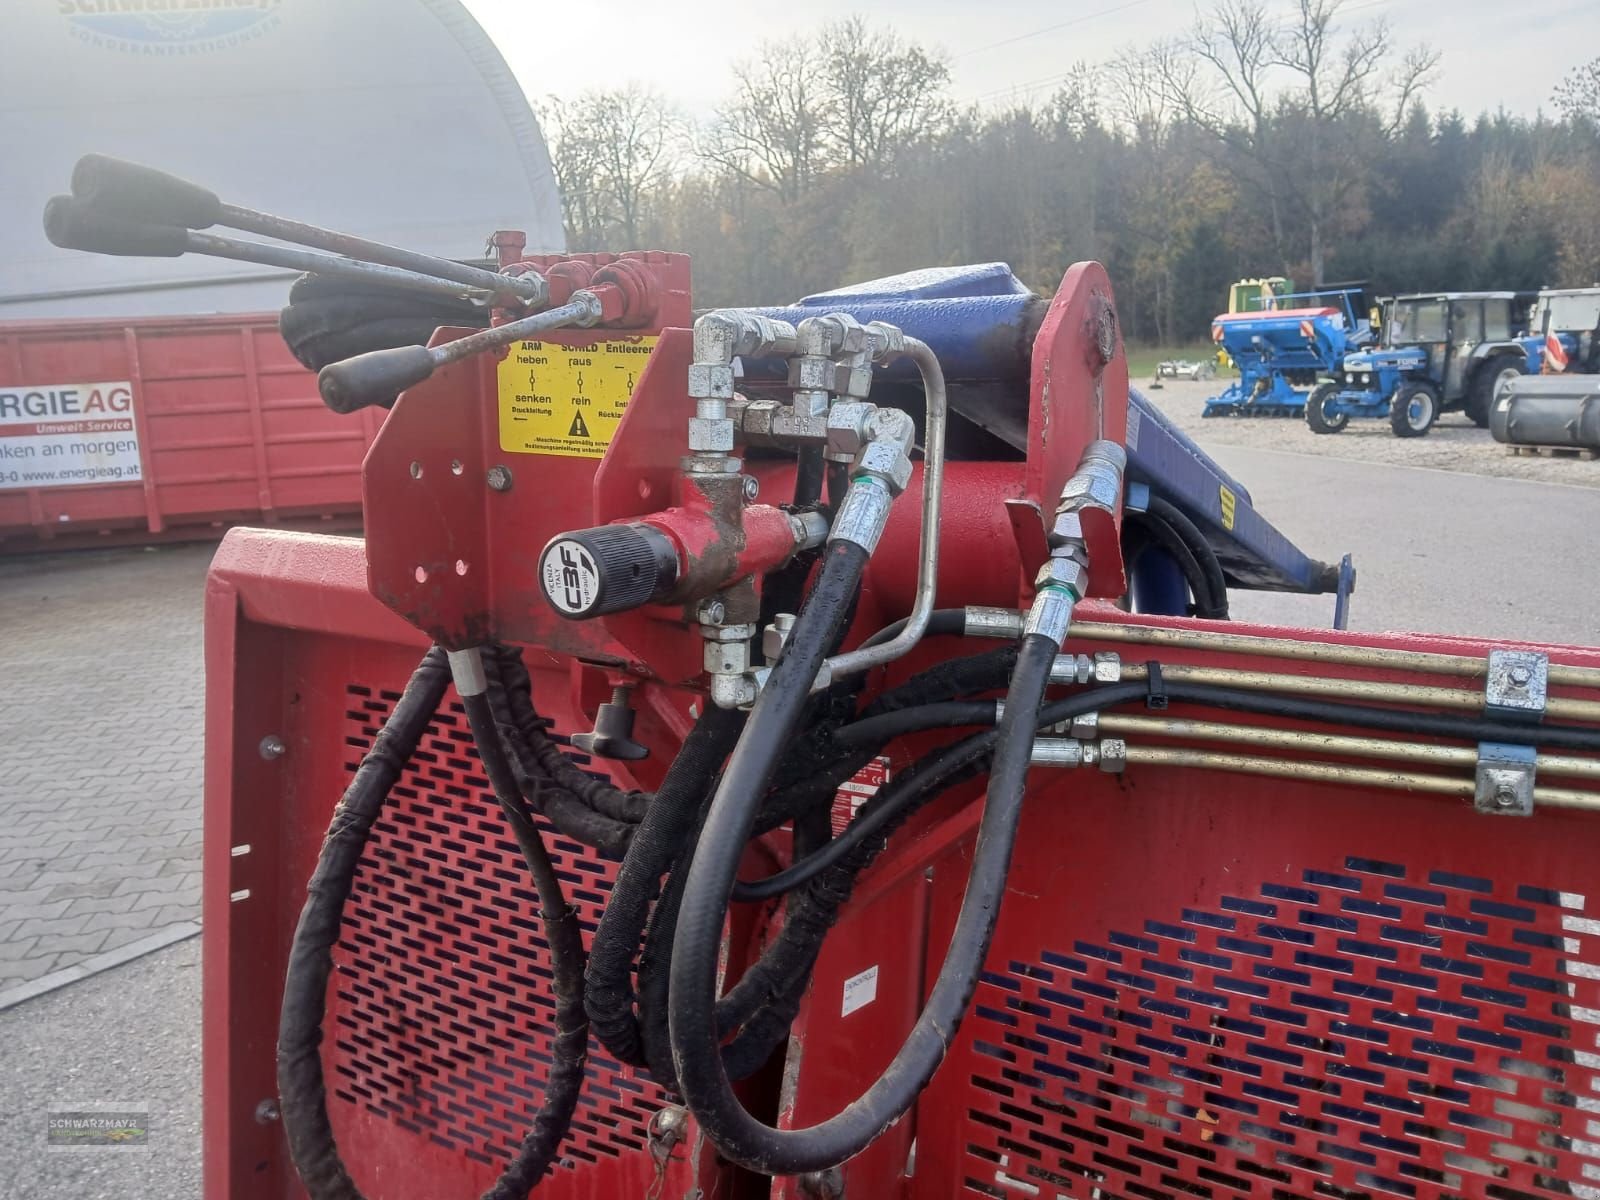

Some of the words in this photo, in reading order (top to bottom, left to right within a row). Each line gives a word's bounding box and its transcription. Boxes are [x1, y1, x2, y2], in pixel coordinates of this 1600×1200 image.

[521, 342, 542, 351] ARM
[516, 355, 548, 364] heben
[569, 357, 592, 367] raus
[515, 394, 552, 404] senken
[571, 396, 591, 406] rein
[511, 406, 552, 416] Druckleitung
[36, 421, 84, 434] Umwelt
[87, 420, 131, 431] Service
[42, 443, 64, 456] an
[71, 440, 137, 456] morgen
[22, 464, 140, 481] www.energieag.at
[546, 563, 555, 597] VICENZA
[554, 567, 562, 589] ITALY
[560, 546, 582, 609] CBF
